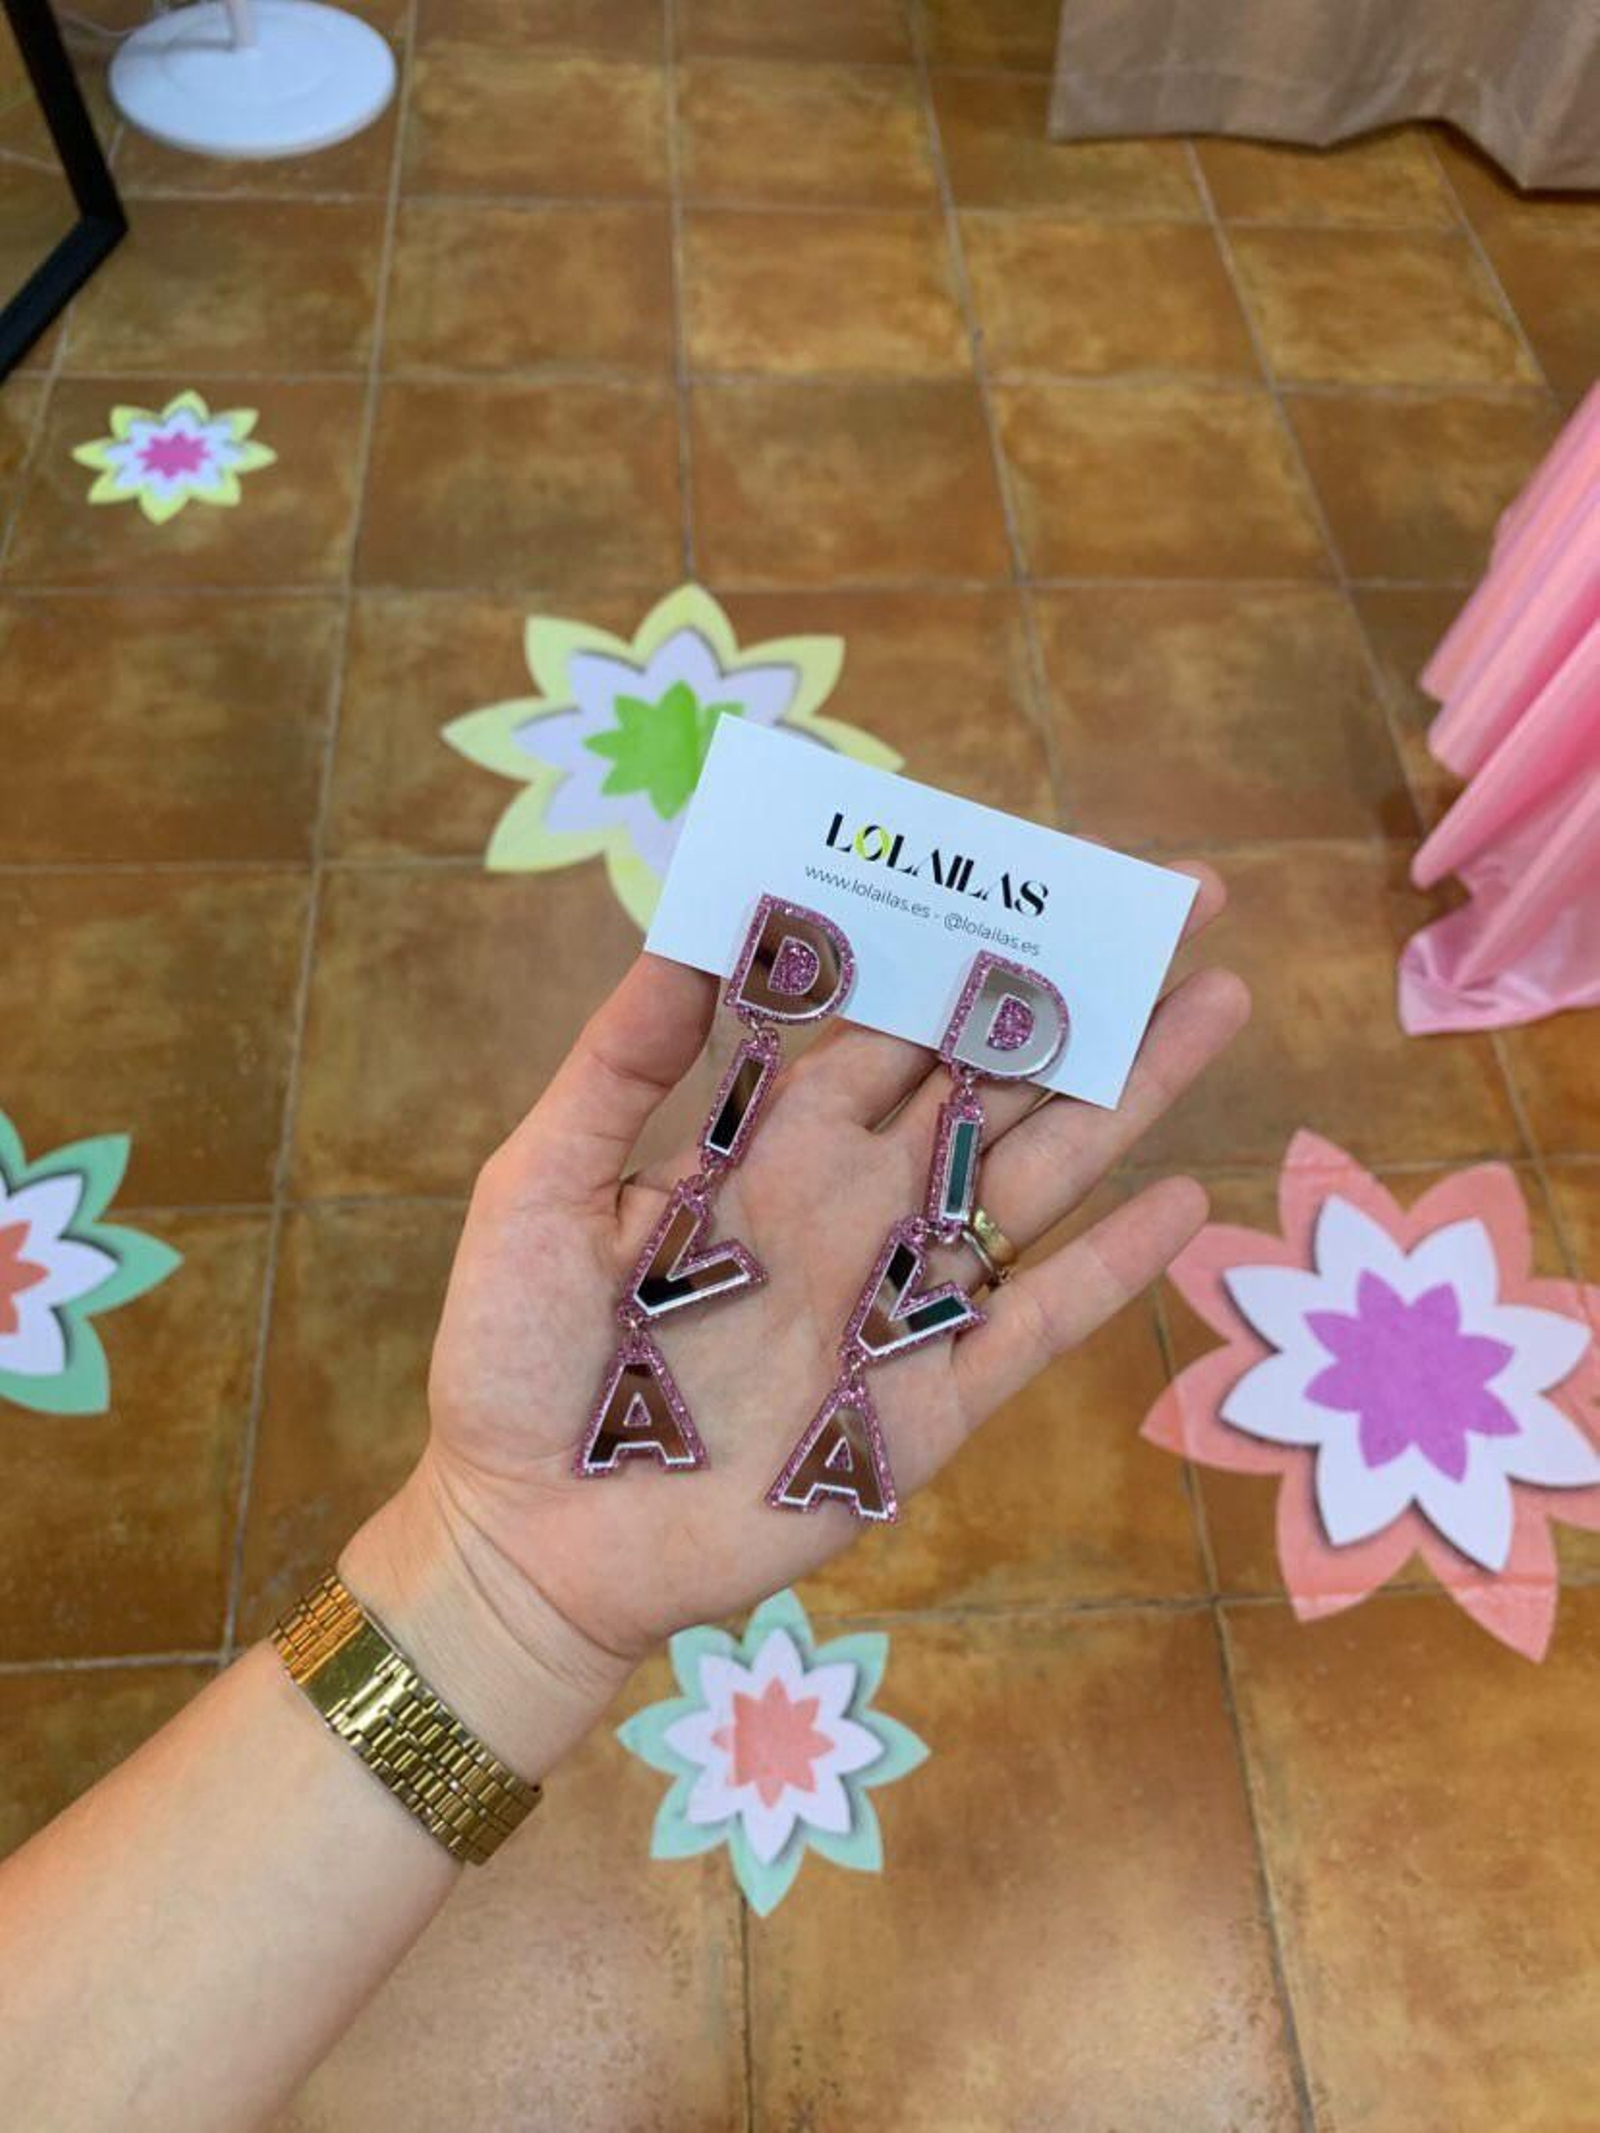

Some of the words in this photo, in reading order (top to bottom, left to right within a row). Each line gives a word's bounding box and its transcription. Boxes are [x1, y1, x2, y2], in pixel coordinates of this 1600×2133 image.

[805, 864, 930, 919] www.lolailas.es
[944, 912, 1041, 956] @lolailas.es
[826, 812, 1049, 917] LOLAILAS
